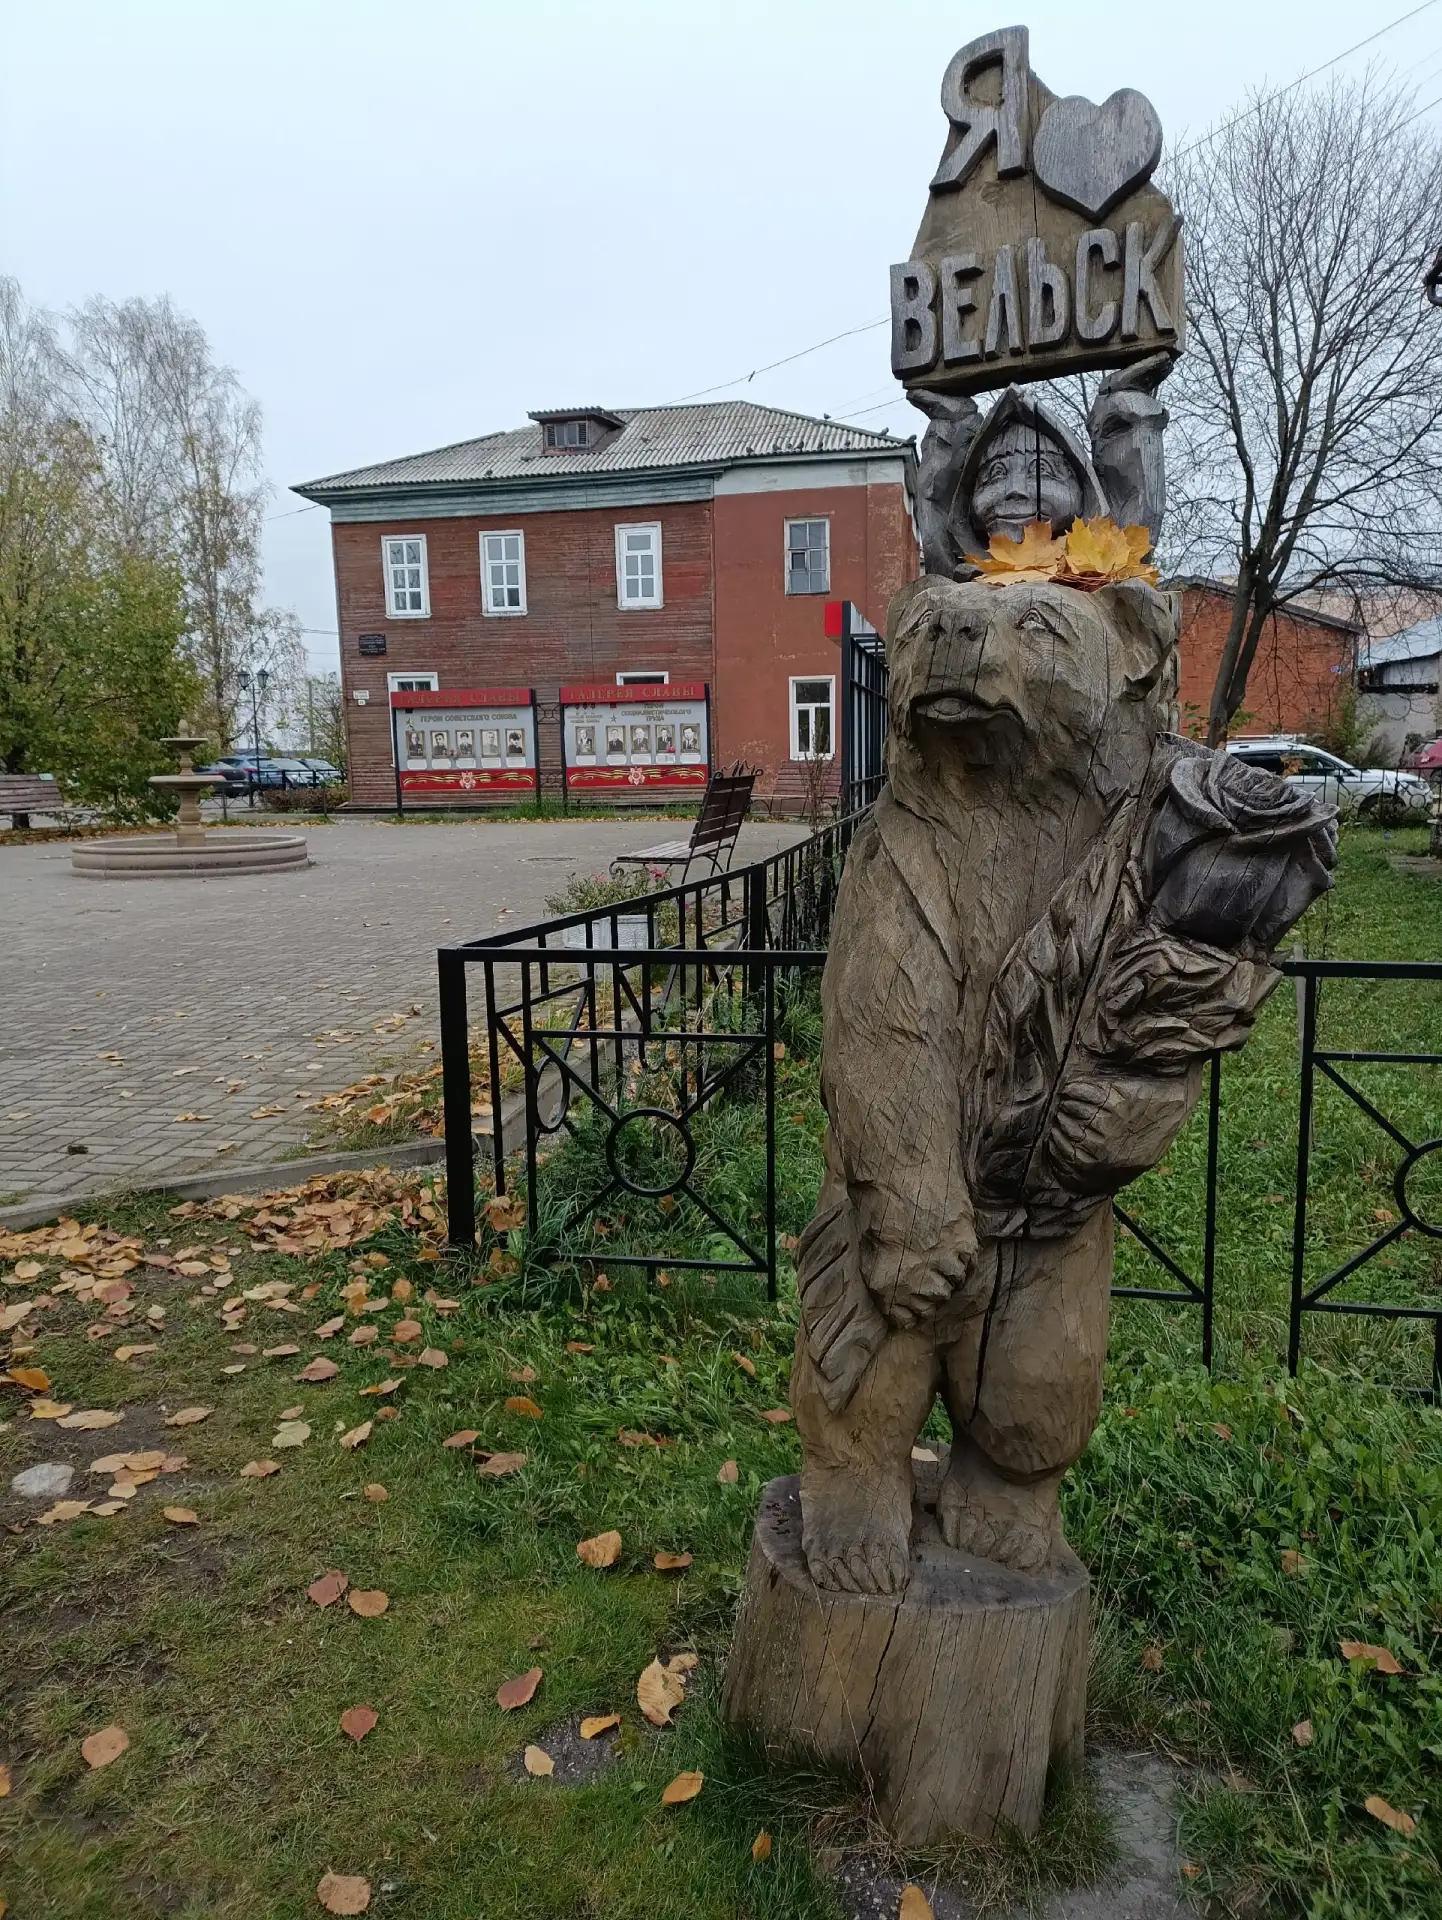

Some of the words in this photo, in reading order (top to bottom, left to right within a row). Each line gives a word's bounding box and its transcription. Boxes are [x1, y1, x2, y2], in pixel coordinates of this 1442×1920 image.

[929, 24, 1029, 194] Я
[890, 214, 1183, 380] ВЕЛЬСК
[469, 692, 520, 702] СЛАВЫ
[569, 689, 633, 699] ГАЛЕРЕЯ
[642, 687, 694, 697] СЛАВЫ
